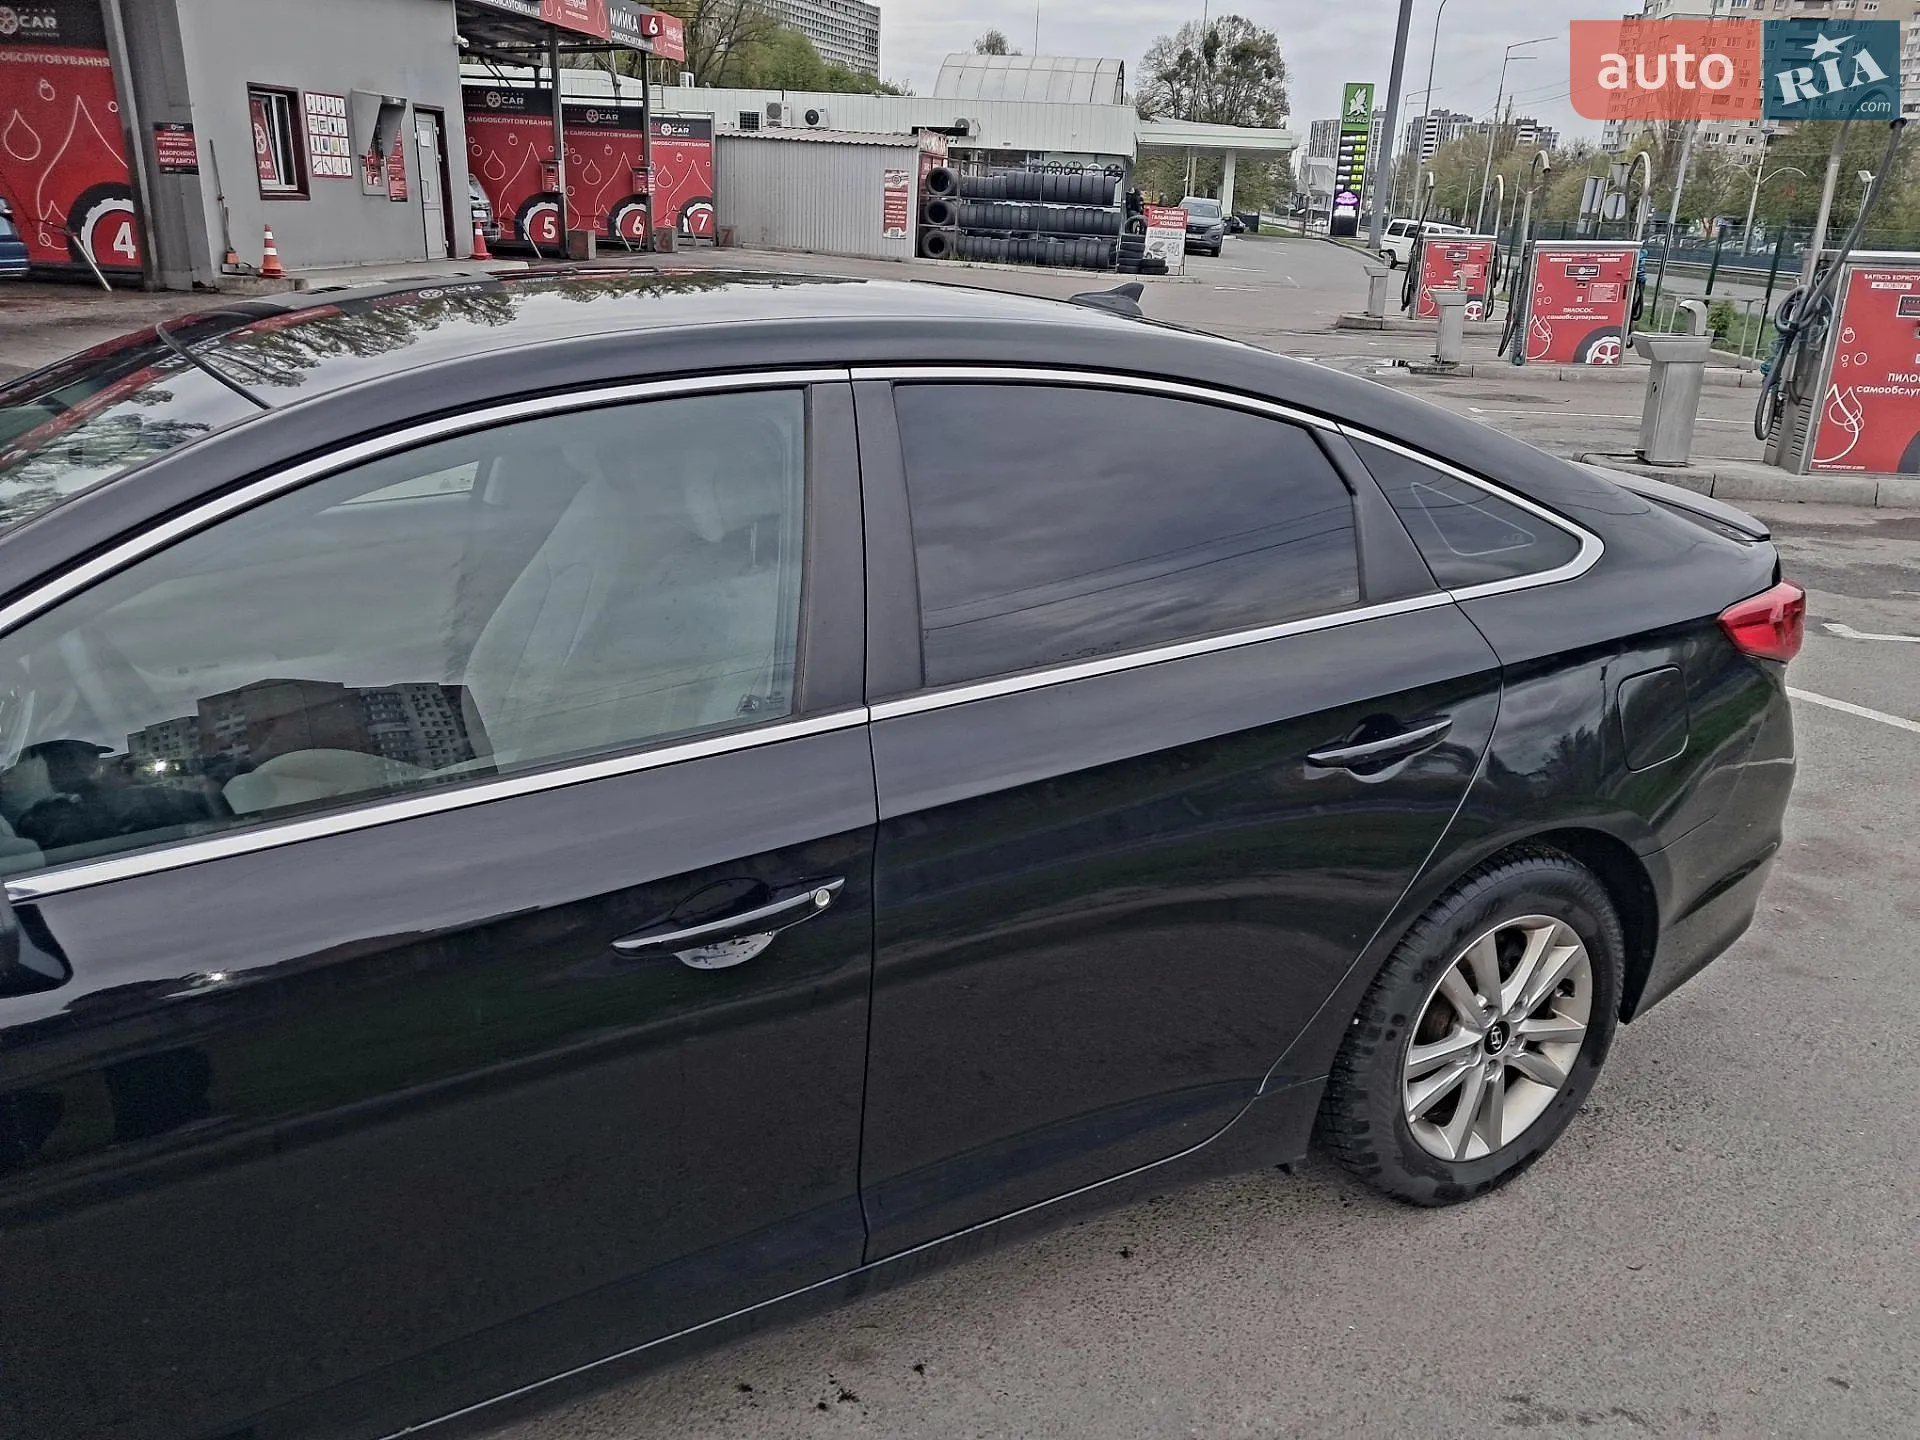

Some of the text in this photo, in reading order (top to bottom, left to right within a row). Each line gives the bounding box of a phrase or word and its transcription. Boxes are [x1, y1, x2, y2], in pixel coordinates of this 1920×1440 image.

[19, 15, 57, 29] CAR
[609, 6, 640, 34] МИЙКА
[649, 17, 659, 35] 6
[501, 96, 525, 105] CAR
[467, 116, 553, 127] САМООБСЛУГОВУВАННЯ
[599, 113, 619, 121] CAR
[542, 216, 556, 239] 5
[632, 215, 643, 235] 6
[696, 213, 709, 232] 7
[112, 221, 136, 260] 4
[1887, 372, 1920, 383] ПИЛО
